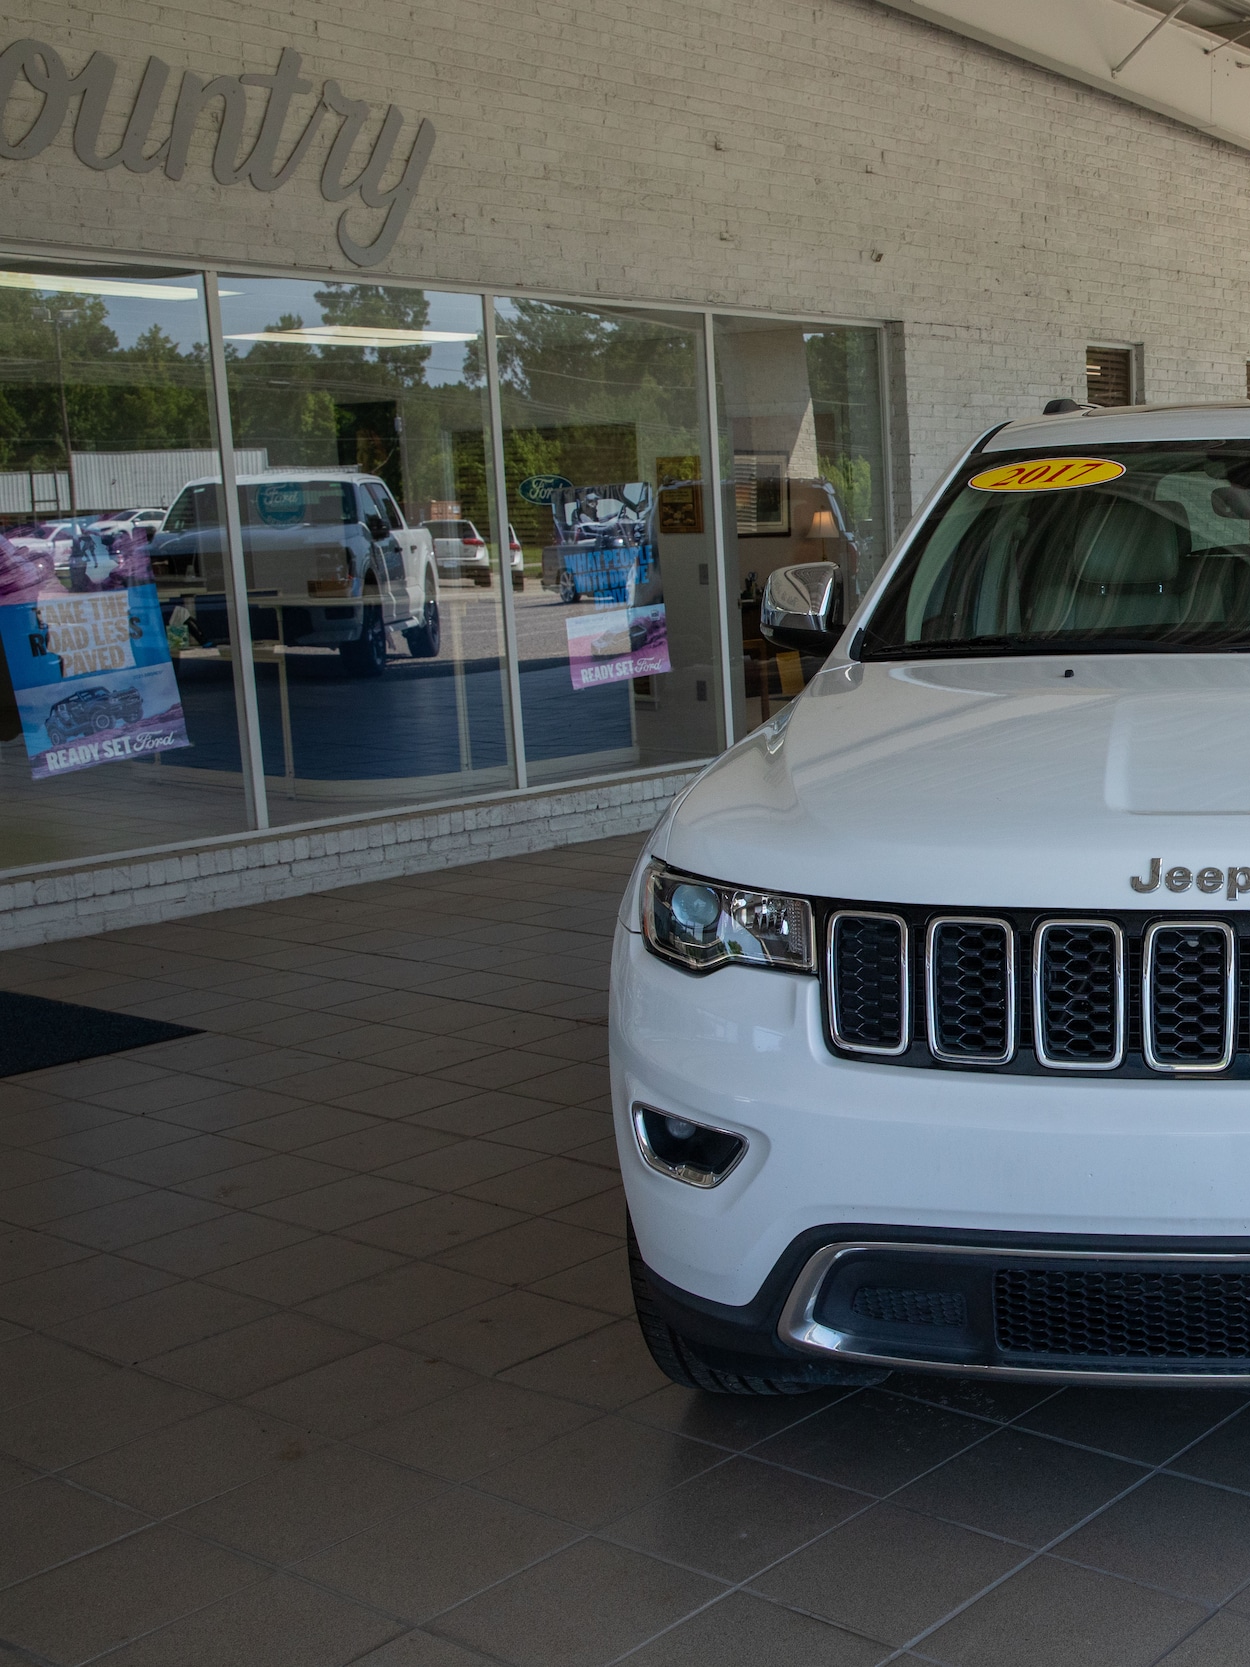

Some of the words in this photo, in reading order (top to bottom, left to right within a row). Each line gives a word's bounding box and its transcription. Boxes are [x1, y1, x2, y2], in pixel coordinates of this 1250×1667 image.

[530, 478, 563, 499] For
[989, 463, 1105, 487] 2017
[264, 481, 299, 505] Ford
[564, 551, 601, 574] WHAT
[603, 544, 654, 569] PEOPLE
[573, 571, 609, 593] WITH
[609, 565, 649, 588] DRVE
[32, 601, 89, 629] TAKE
[88, 594, 131, 620] THE
[593, 586, 632, 611] DRIV
[28, 626, 90, 657] ROAD
[91, 617, 144, 646] LESS
[60, 645, 125, 678] PAVED
[580, 663, 614, 683] READY
[615, 660, 634, 676] SET
[634, 657, 662, 673] Ford
[46, 743, 101, 771] READY
[103, 736, 131, 758] SET
[133, 729, 175, 751] Ford
